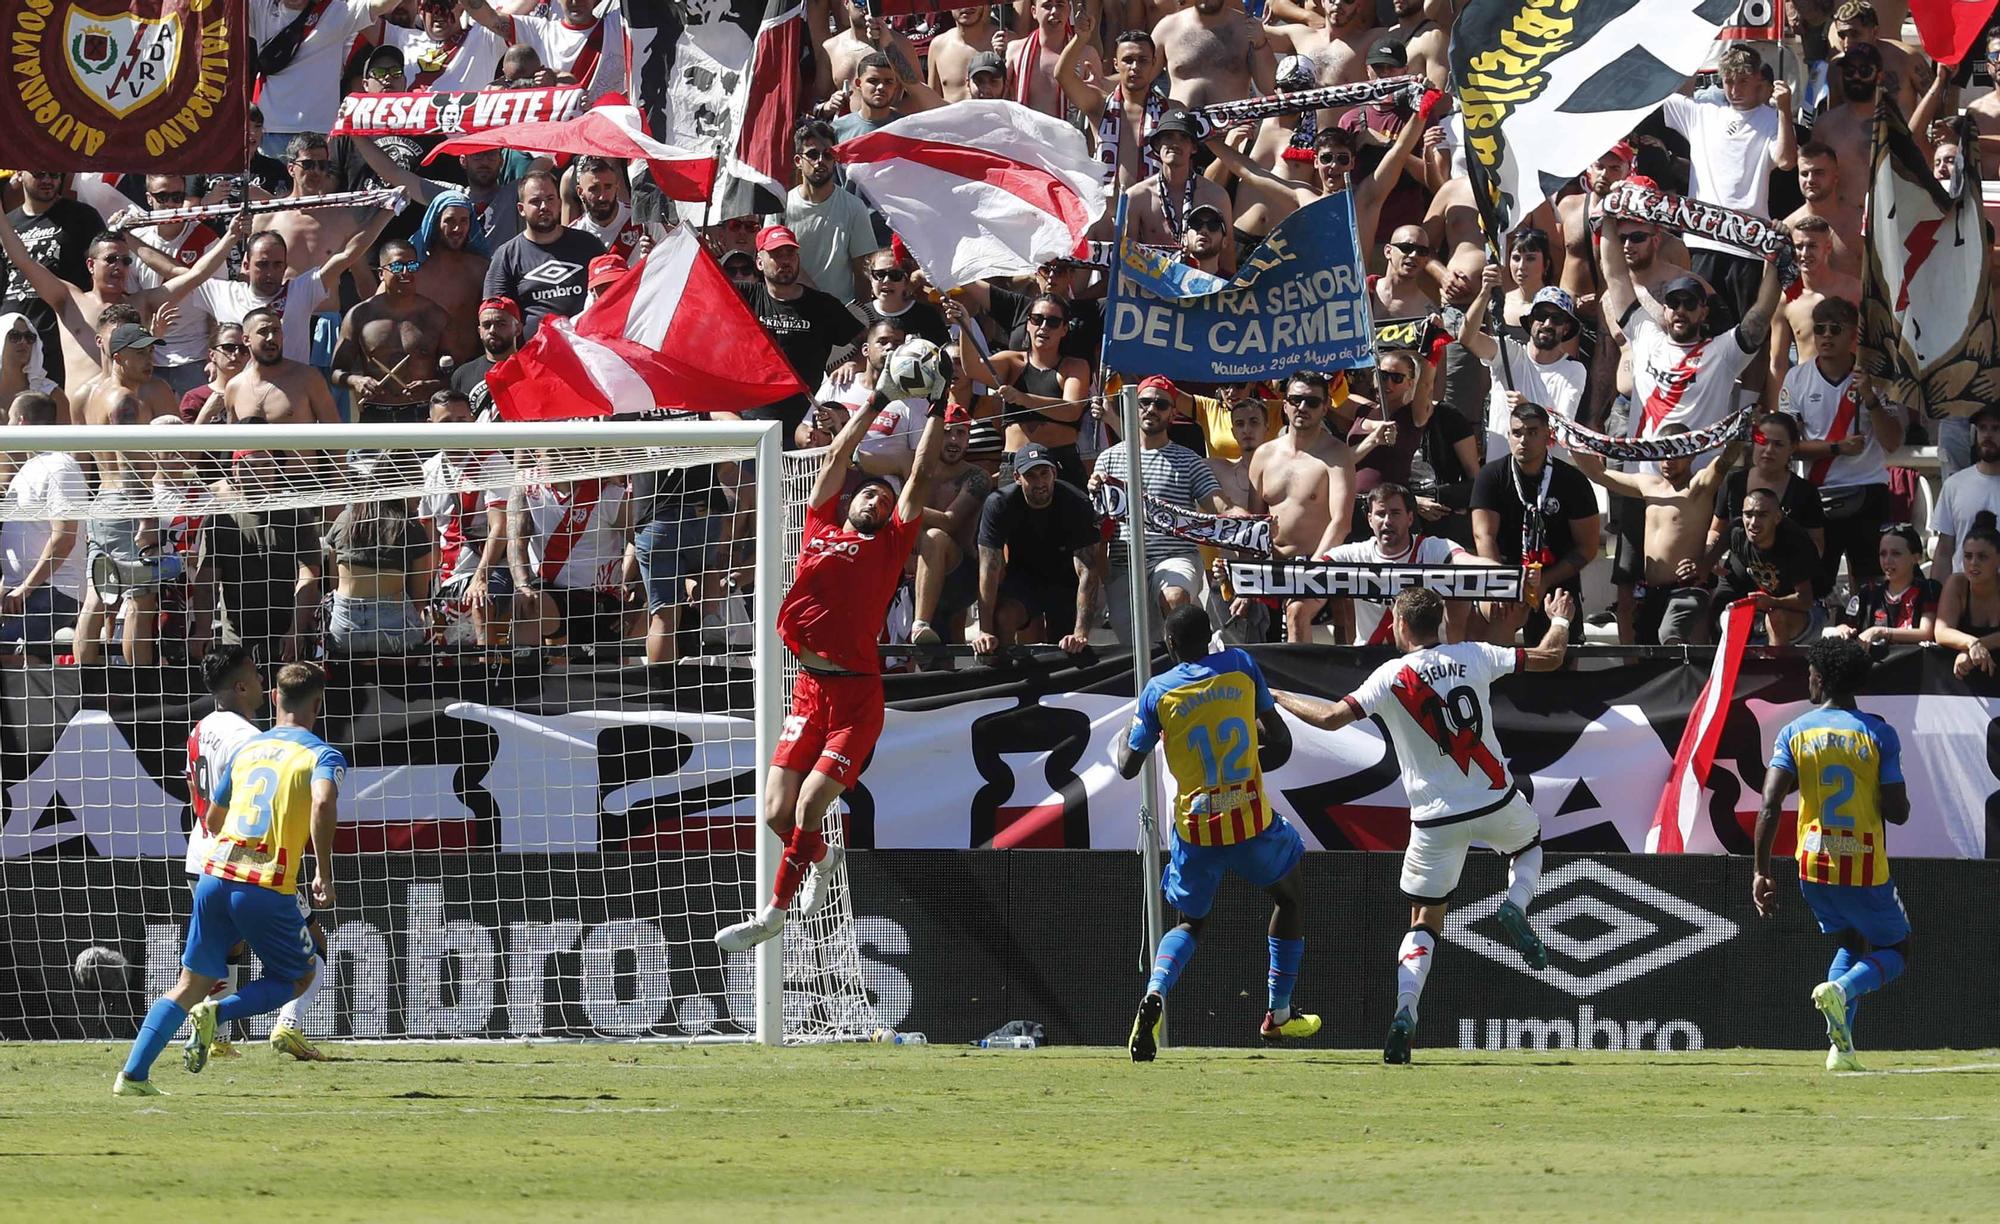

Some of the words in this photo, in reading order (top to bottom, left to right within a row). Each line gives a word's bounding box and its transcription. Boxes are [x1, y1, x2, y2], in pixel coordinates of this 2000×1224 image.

[472, 91, 543, 128] VETE
[532, 284, 583, 301] umbro
[1112, 302, 1194, 352] DEL
[1238, 565, 1521, 599] BUKANEROS
[1421, 685, 1484, 756] 19
[1187, 715, 1254, 788] 12
[234, 766, 280, 838] 3
[1819, 763, 1856, 830] 2
[1457, 1004, 1705, 1051] umbro
